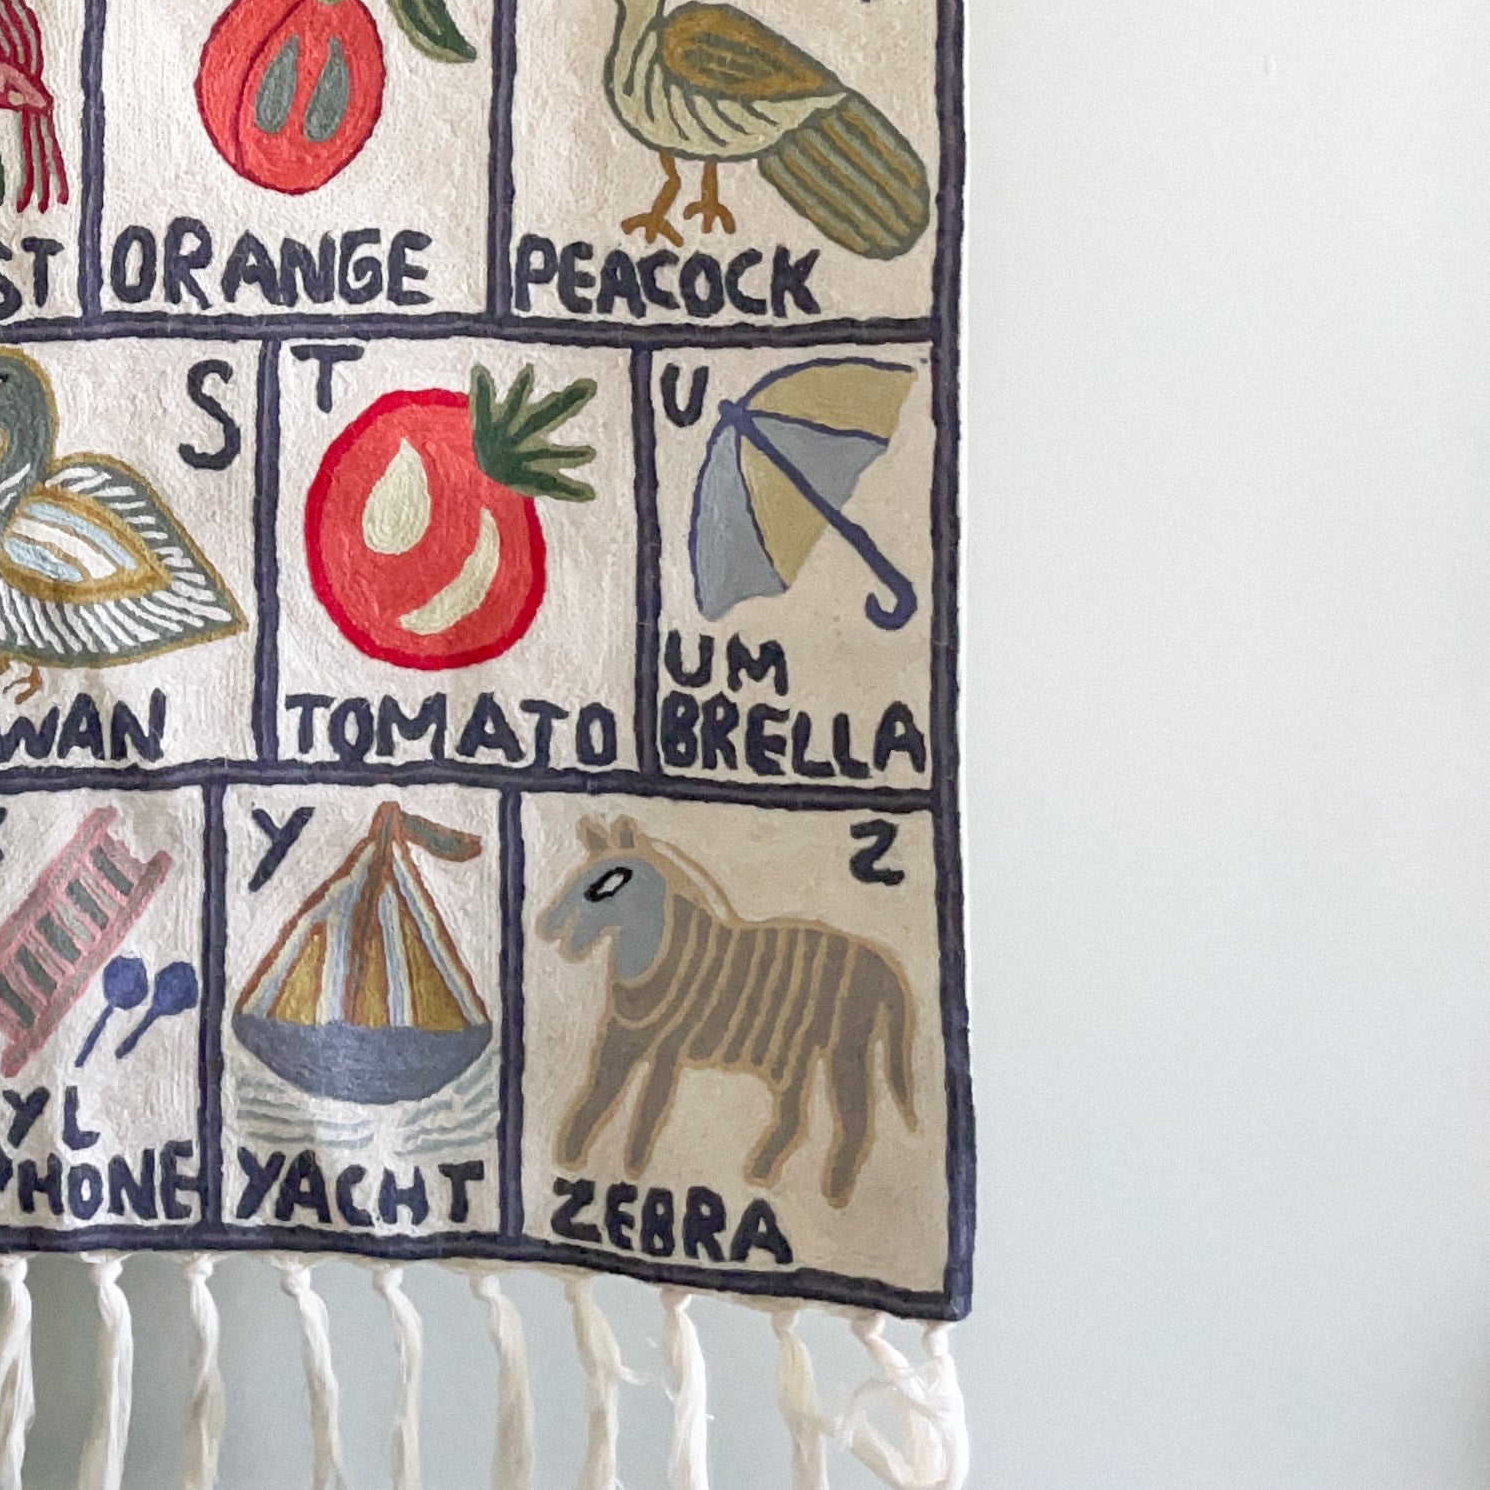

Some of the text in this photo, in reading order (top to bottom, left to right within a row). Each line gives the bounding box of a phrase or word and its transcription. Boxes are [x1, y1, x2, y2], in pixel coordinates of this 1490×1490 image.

[111, 218, 431, 309] ORANGE
[515, 234, 820, 319] PEACOCK
[179, 360, 240, 470] S
[291, 345, 365, 412] T
[661, 364, 708, 427] U
[664, 630, 788, 696] UM
[284, 693, 617, 769] TOMATO
[660, 691, 926, 777] BRELLA
[249, 807, 316, 891] Y
[850, 819, 905, 886] Z
[235, 1157, 484, 1228] YACHT
[549, 1178, 793, 1265] ZEBRA
